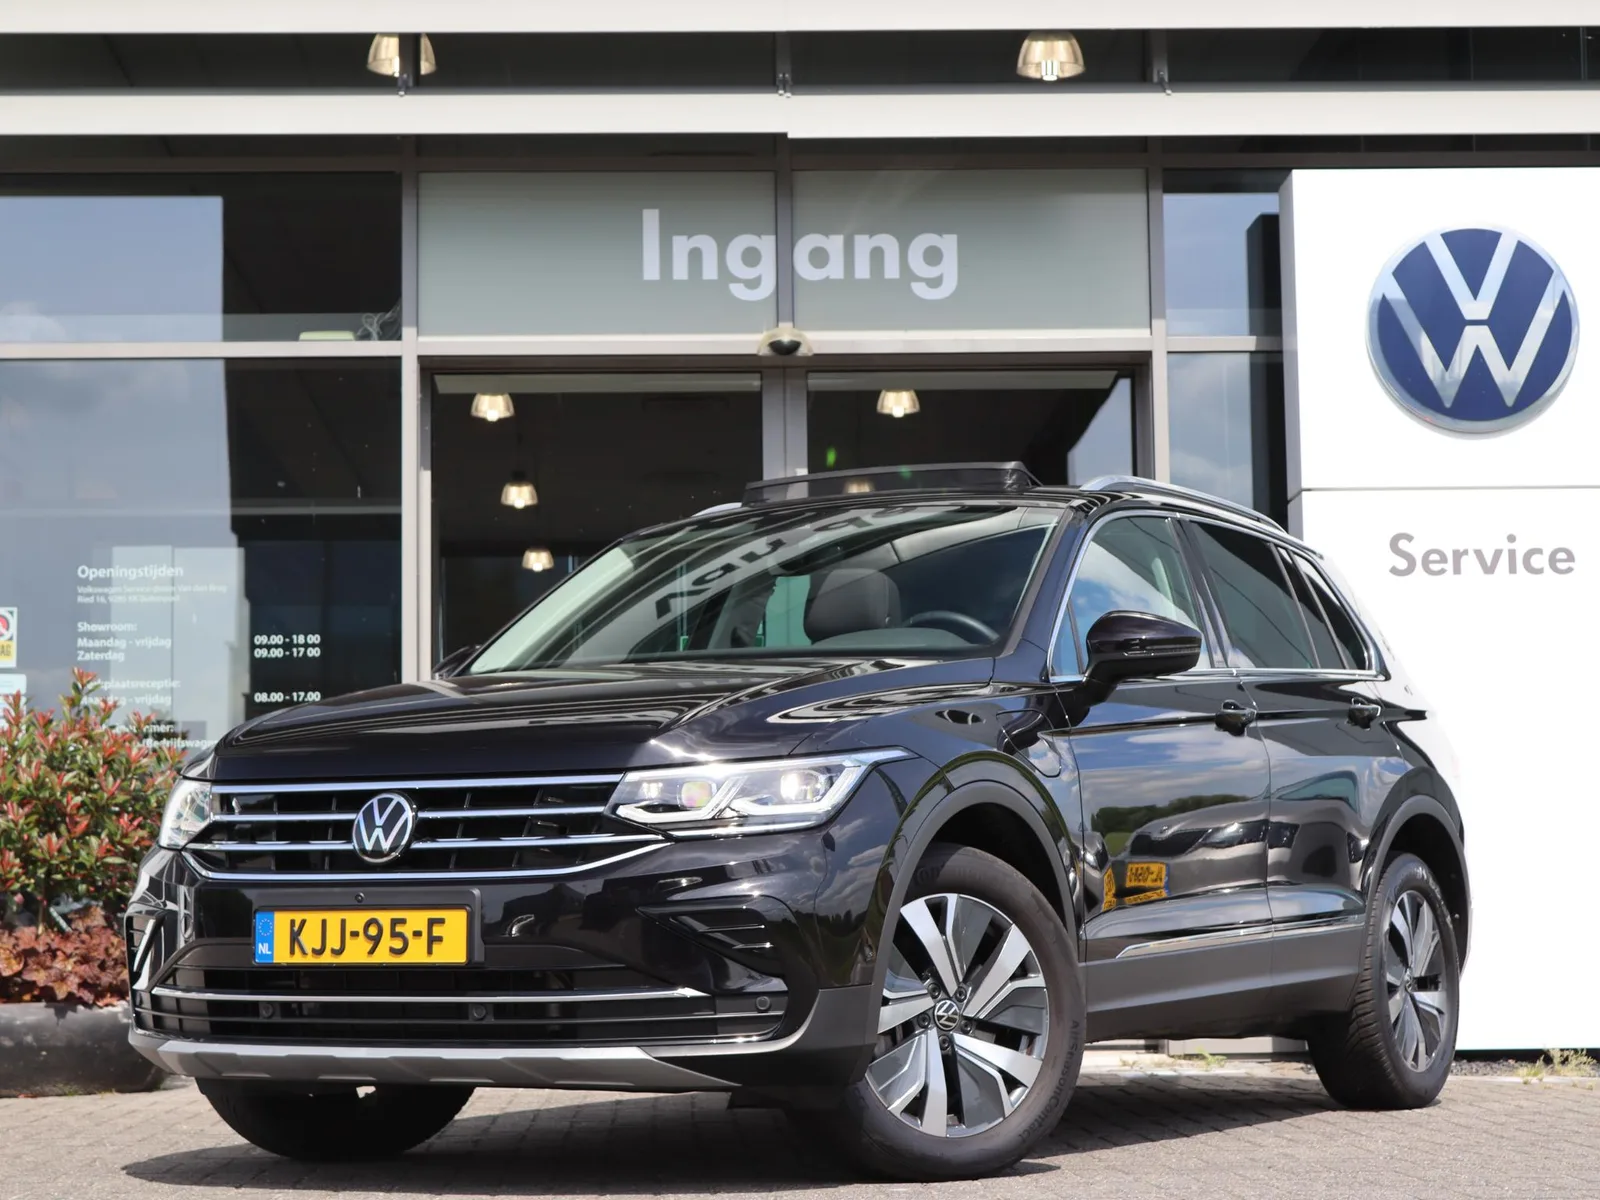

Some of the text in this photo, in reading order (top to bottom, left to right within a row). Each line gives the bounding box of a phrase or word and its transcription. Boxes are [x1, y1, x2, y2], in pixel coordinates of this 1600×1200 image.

[642, 208, 958, 301] Ingang
[1388, 532, 1576, 577] Service
[76, 564, 184, 580] Openingstijden
[76, 621, 138, 633] Showroom:
[76, 637, 127, 649] Maandag
[134, 636, 172, 649] vrijdag
[253, 634, 284, 645] 09.00
[76, 650, 126, 663] Zaterdag
[253, 648, 284, 658] 09.00
[134, 694, 172, 707] vrijdag
[253, 692, 284, 702] 08.00
[292, 691, 322, 702] 17.00
[258, 917, 446, 957] NL KJJ-95-F
